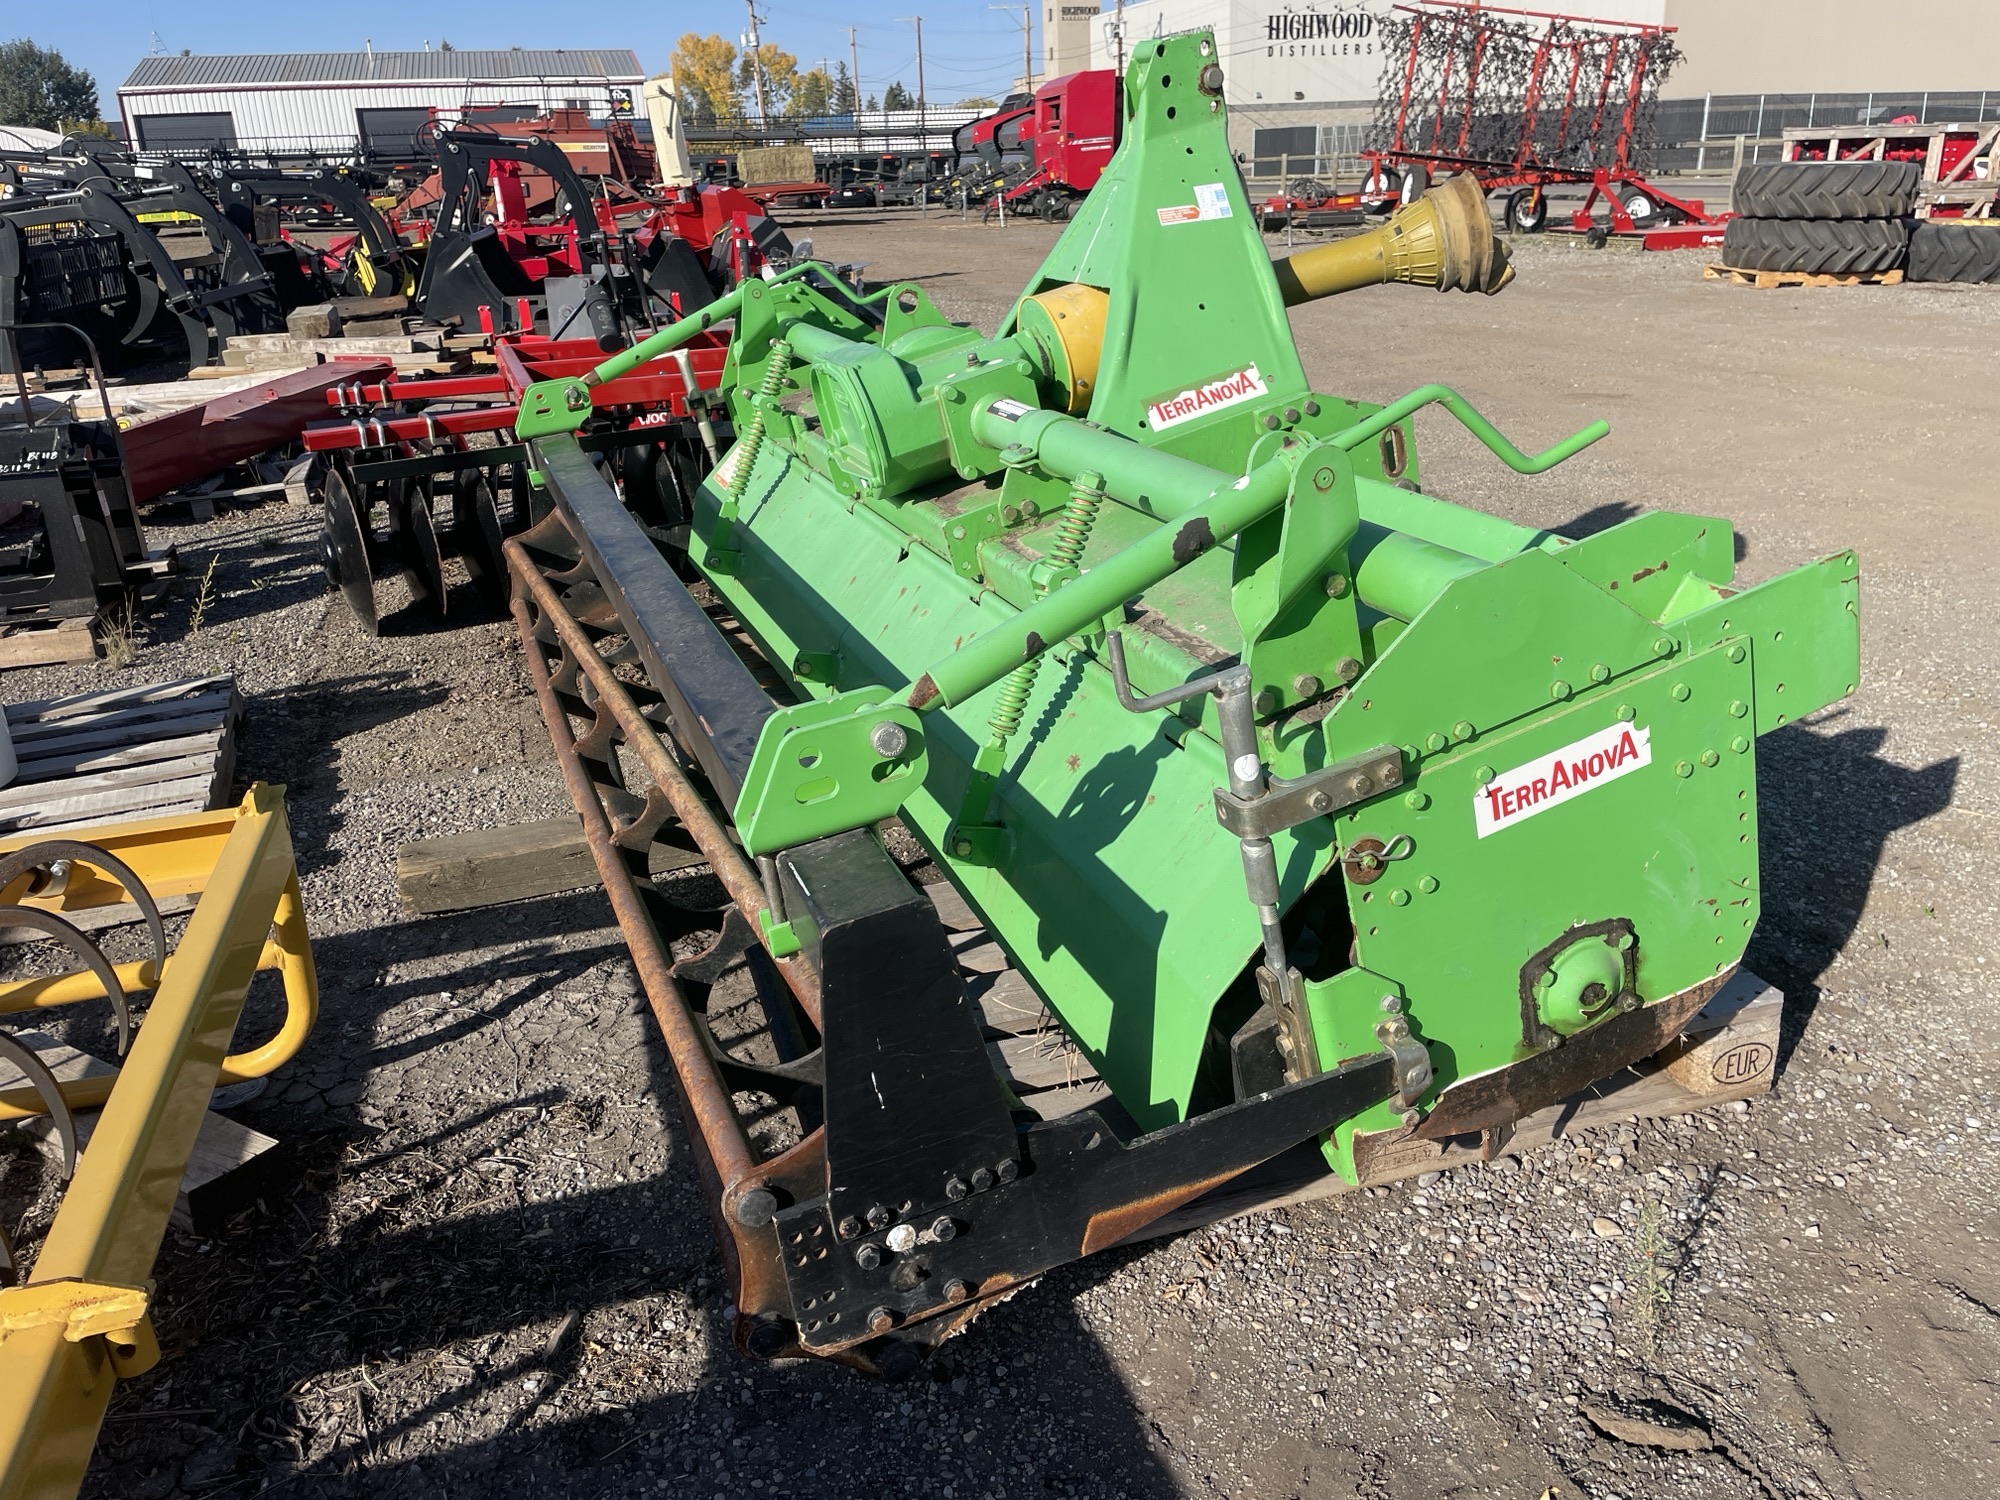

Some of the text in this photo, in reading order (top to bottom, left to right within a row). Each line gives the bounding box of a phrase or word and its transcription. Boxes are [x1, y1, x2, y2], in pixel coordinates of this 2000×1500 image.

[1267, 13, 1371, 40] HIGHWOOD
[1267, 43, 1372, 57] DISTILLERS
[1725, 1048, 1760, 1079] EUR
